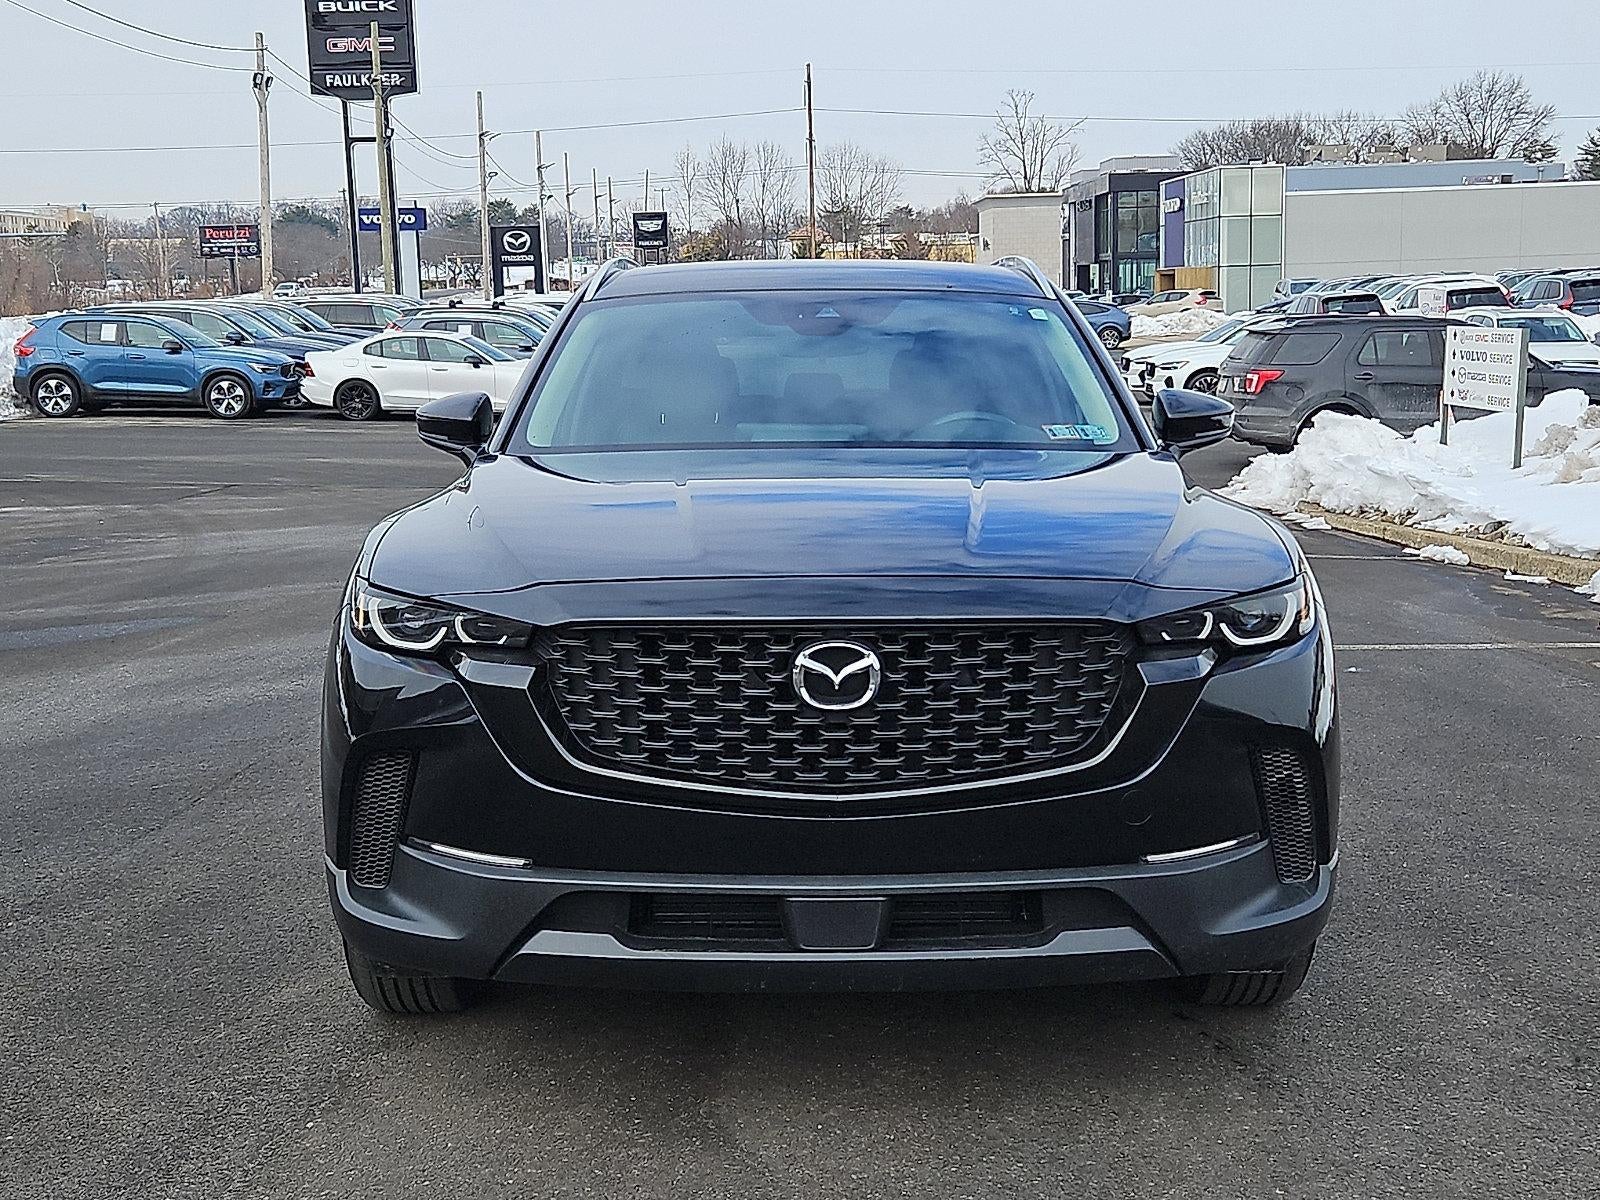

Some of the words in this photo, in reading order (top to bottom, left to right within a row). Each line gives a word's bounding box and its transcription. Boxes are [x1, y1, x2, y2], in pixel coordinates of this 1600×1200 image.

[318, 0, 398, 12] BUICK
[327, 37, 394, 52] GMC
[325, 74, 403, 87] FAULKER
[360, 214, 416, 225] VOVO
[1491, 333, 1515, 344] SERVICE
[1460, 350, 1487, 362] VOLVO
[1489, 353, 1513, 364] SERVICE
[1488, 374, 1512, 385] SERVICE
[1487, 396, 1510, 407] SERVICE
